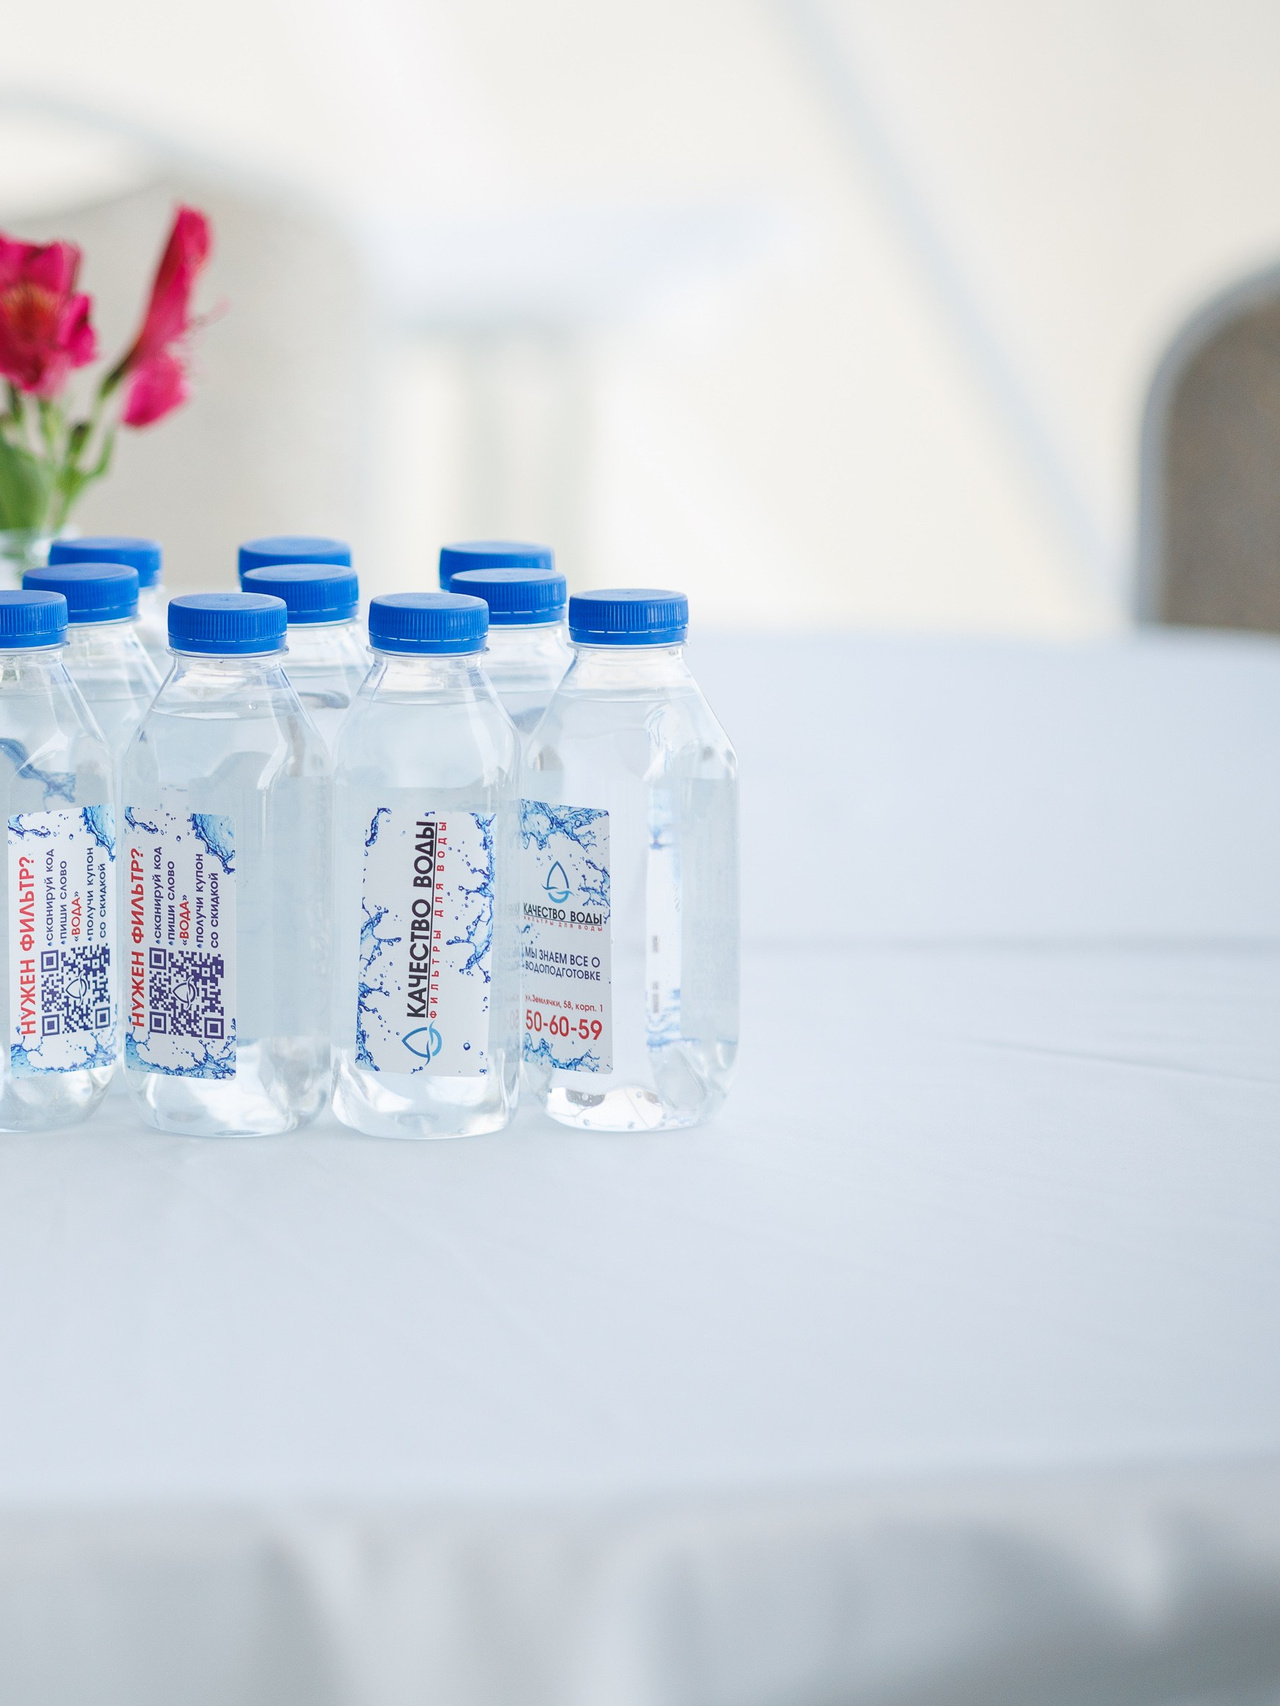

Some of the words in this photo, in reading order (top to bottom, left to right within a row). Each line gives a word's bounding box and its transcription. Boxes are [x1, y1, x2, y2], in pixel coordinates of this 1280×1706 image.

[45, 849, 55, 873] код
[85, 847, 95, 886] купон
[152, 847, 162, 870] код
[413, 821, 436, 888] ВОДЫ
[436, 822, 447, 872] ВОДЫ
[59, 860, 67, 900] слово
[97, 863, 107, 917] скидкой
[131, 848, 144, 944] ФИЛЬТР?
[167, 860, 175, 901] слово
[195, 854, 205, 893] купон
[18, 856, 35, 952] ФИЛЬТР?
[44, 876, 56, 941] сканируй
[71, 891, 82, 942] «ВОДА»
[86, 890, 96, 936] получи
[153, 874, 163, 939] сканируй
[167, 905, 175, 940] пиши
[179, 894, 191, 946] «ВОДА»
[195, 897, 205, 943] получи
[209, 872, 219, 928] скидкой
[434, 883, 444, 918] ДЛЯ
[523, 902, 566, 921] КАЧЕСТВО
[570, 910, 602, 925] ВОДЫ
[99, 922, 107, 938] со
[210, 932, 219, 948] со
[407, 898, 432, 1017] КАЧЕСТВО
[429, 930, 442, 1018] ФИЛЬТРЫ
[525, 946, 537, 959] МЫ
[539, 949, 567, 964] ЗНАЕМ
[570, 954, 588, 966] ВСЕ
[591, 957, 600, 968] О
[525, 960, 601, 981] ВОДОПОДГОТОВКЕ
[19, 959, 36, 1035] НУЖЕН
[131, 951, 144, 1028] НУЖЕН
[563, 1000, 574, 1010] 58,
[575, 1003, 597, 1012] корп.
[525, 1009, 603, 1041] 50-60-59
